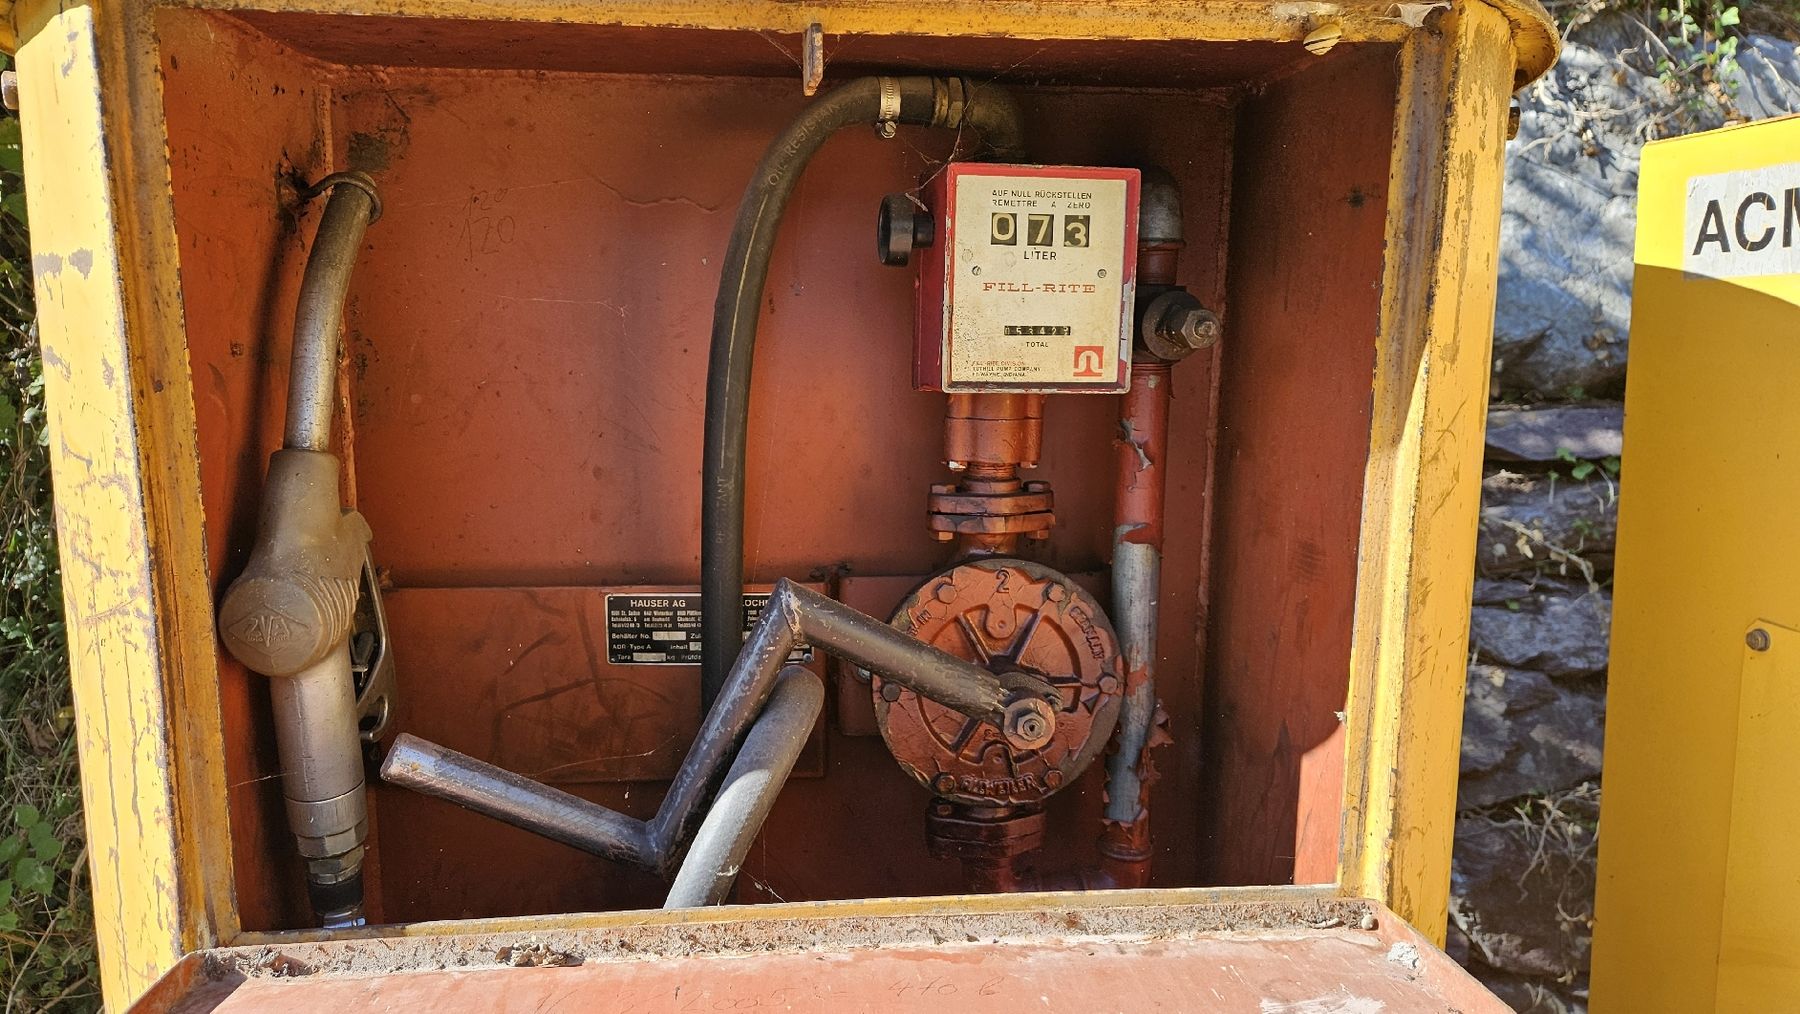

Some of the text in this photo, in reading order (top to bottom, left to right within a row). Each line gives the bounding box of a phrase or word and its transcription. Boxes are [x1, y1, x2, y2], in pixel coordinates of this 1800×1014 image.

[992, 189, 1092, 199] AUF NULL RÜCKSTELLEN
[1023, 250, 1057, 260] LITER
[982, 282, 1096, 293] FILL-RITE
[996, 569, 1010, 593] 2
[630, 599, 669, 608] HAUSER
[672, 599, 686, 607] AG
